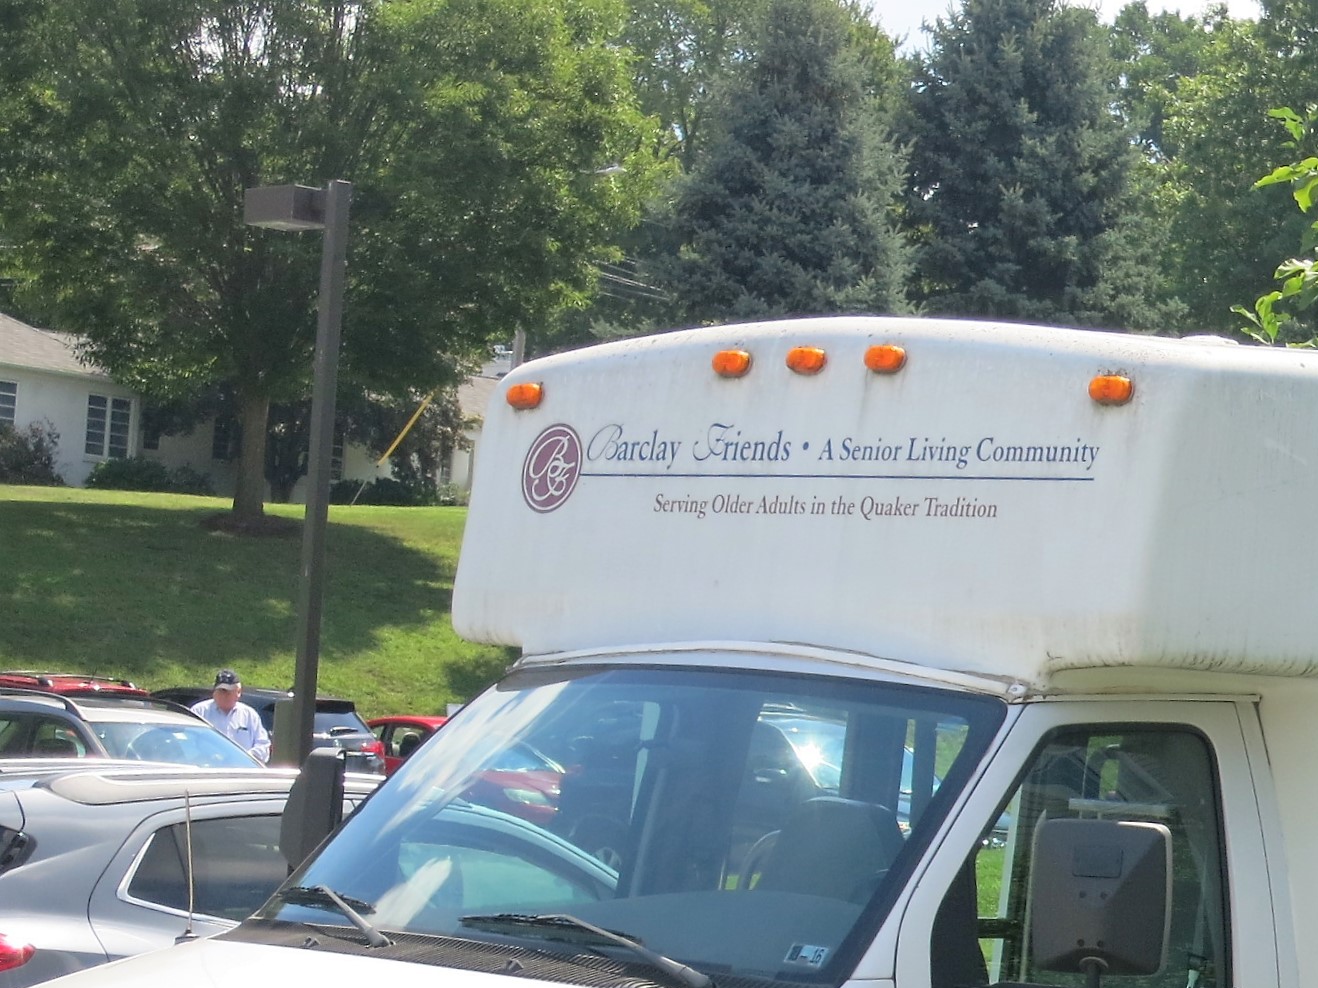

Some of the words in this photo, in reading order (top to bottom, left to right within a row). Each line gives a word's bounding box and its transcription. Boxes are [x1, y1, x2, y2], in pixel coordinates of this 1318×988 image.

[586, 423, 681, 470] Barclay
[693, 423, 792, 462] Friends
[818, 438, 834, 461] A
[839, 437, 902, 462] Senior
[906, 437, 971, 470] Living
[976, 436, 1100, 471] Community
[653, 493, 708, 519] Serving
[711, 494, 752, 515] Older
[755, 495, 806, 515] Adults
[810, 495, 826, 516] in
[830, 496, 855, 516] the
[860, 496, 919, 520] Quaker
[923, 496, 998, 519] Tradition
